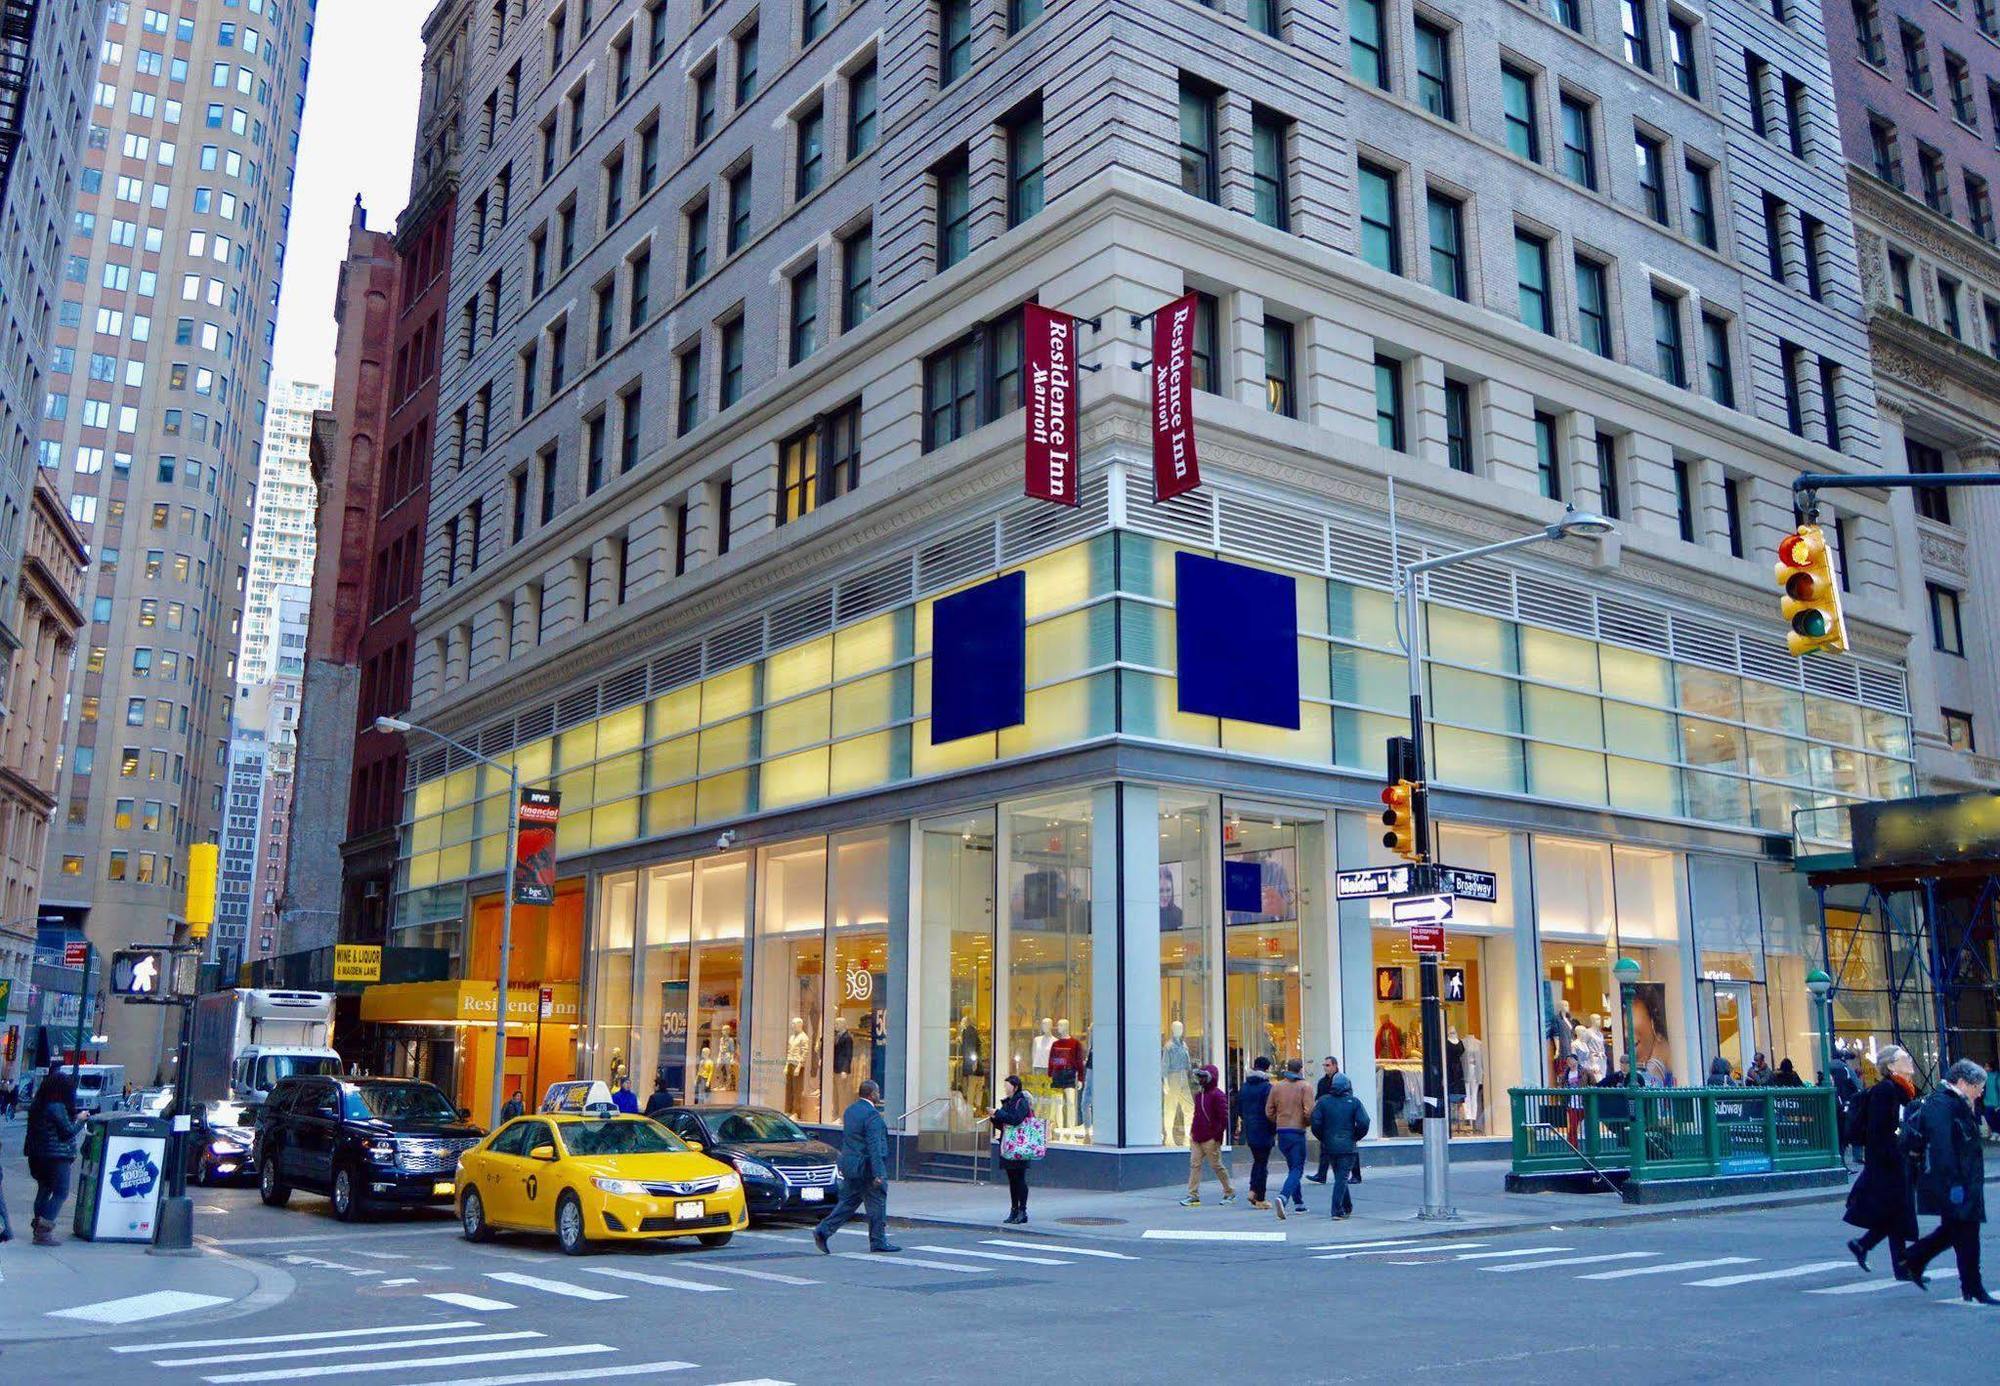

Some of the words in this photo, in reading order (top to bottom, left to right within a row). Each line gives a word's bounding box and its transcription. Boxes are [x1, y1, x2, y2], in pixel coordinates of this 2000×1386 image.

[1050, 320, 1070, 446] Residence
[1170, 306, 1190, 428] Residence
[1033, 362, 1049, 445] Marriott
[1157, 366, 1170, 433] Marriott
[1172, 429, 1188, 480] Inn
[1050, 449, 1069, 496] Inn
[520, 804, 559, 817] financial
[528, 887, 542, 898] bgc
[1456, 877, 1492, 895] Broadway
[337, 949, 351, 963] WINE
[353, 949, 358, 963] &
[359, 949, 380, 964] LIQUOR
[342, 966, 362, 976] MAIDEN
[364, 967, 378, 976] LANE
[120, 1175, 151, 1189] RECYCLED
